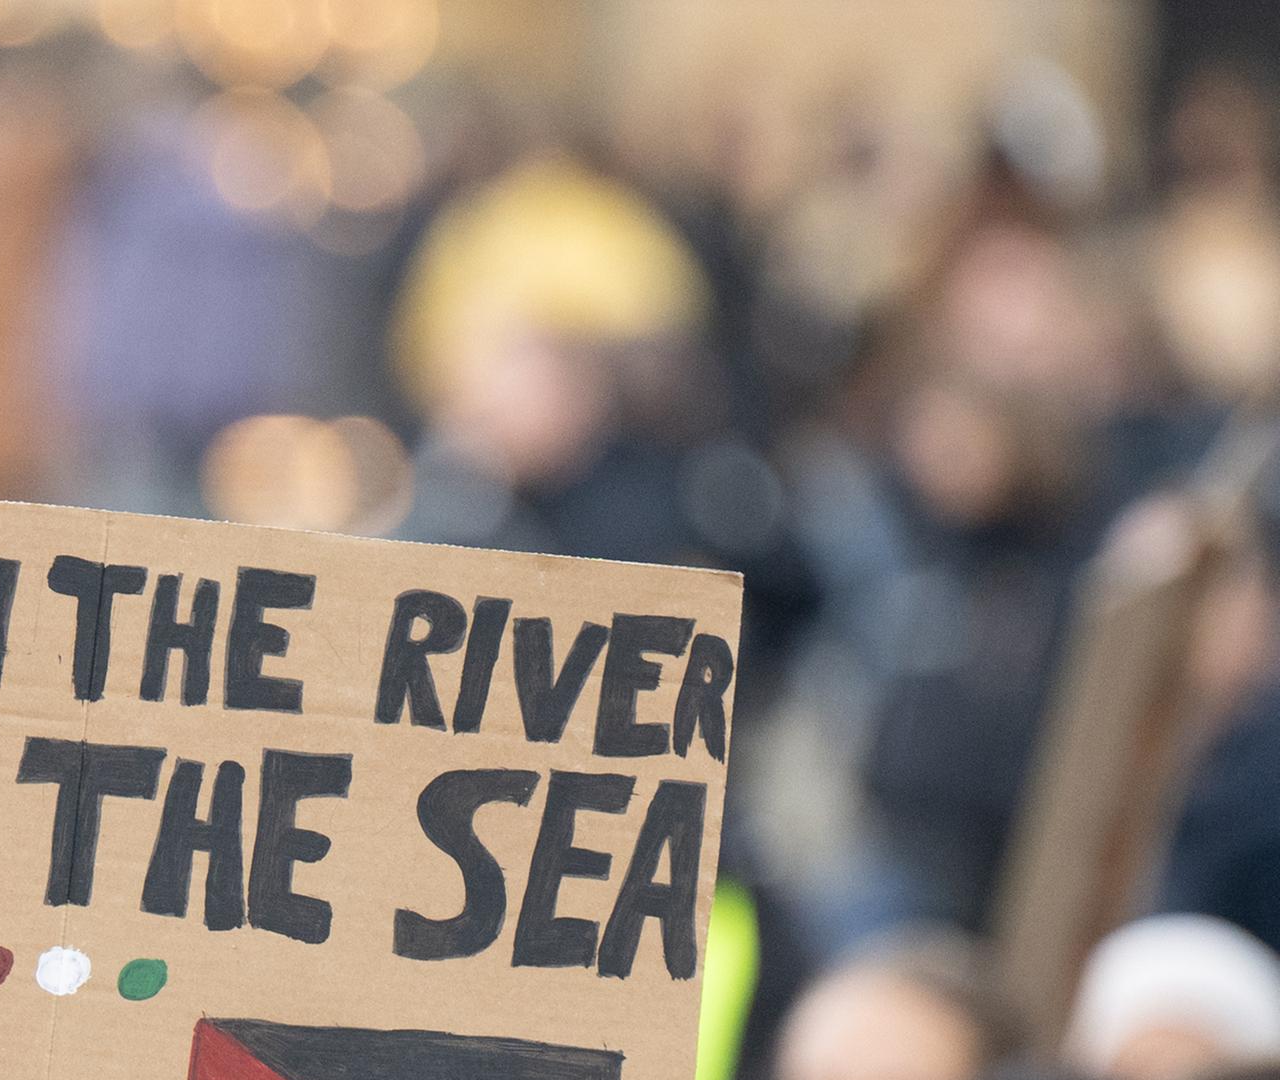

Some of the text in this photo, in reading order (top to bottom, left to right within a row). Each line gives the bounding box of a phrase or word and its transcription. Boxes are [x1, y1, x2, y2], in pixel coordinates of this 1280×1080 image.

[47, 555, 316, 713] THE
[375, 589, 736, 764] RIVER
[16, 737, 353, 945] THE
[393, 769, 708, 980] SEA
